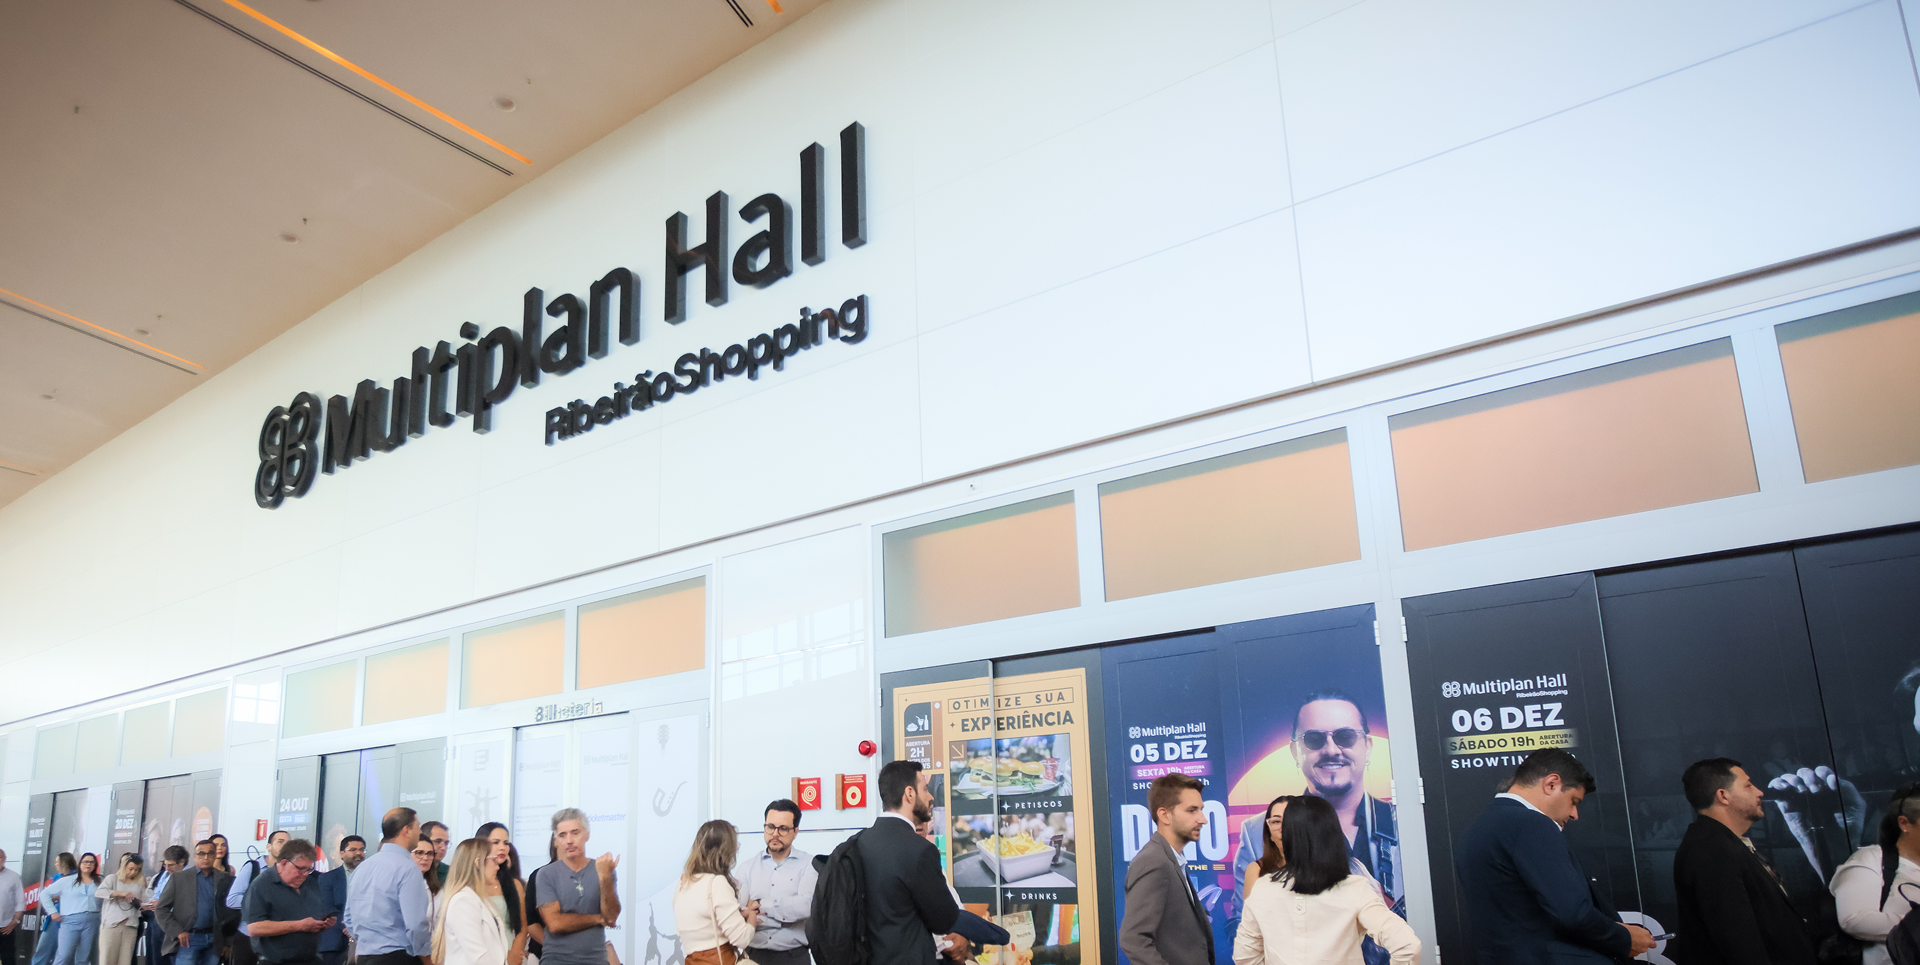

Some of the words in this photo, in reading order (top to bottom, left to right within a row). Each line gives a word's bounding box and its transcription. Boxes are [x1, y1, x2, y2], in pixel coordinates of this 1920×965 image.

[321, 265, 641, 475] Multiplan
[664, 121, 867, 325] Hall
[545, 294, 869, 446] RibeirãoShopping
[1463, 678, 1534, 695] Multiplan
[1536, 673, 1568, 689] Hall
[535, 698, 603, 722] Bilheteria
[952, 696, 1022, 711] OTIMIZE
[1035, 691, 1065, 704] SUA
[961, 710, 1075, 733] EXPERIÊNCIA
[1451, 707, 1493, 732] 06
[1499, 702, 1565, 730] DEZ
[1142, 725, 1186, 737] Multiplan
[1187, 722, 1206, 733] Hall
[910, 747, 925, 758] 2H
[1130, 743, 1159, 763] 05
[1164, 740, 1208, 761] DEZ
[1450, 737, 1507, 751] SÁBADO
[1511, 736, 1535, 747] 19h
[1451, 755, 1530, 769] SHOWTIM
[1137, 768, 1165, 777] SEXTA
[280, 798, 291, 812] 24
[291, 797, 309, 811] OUT
[1015, 800, 1063, 809] PETISCOS
[1121, 800, 1229, 861] DO
[1021, 892, 1058, 900] DRINKS
